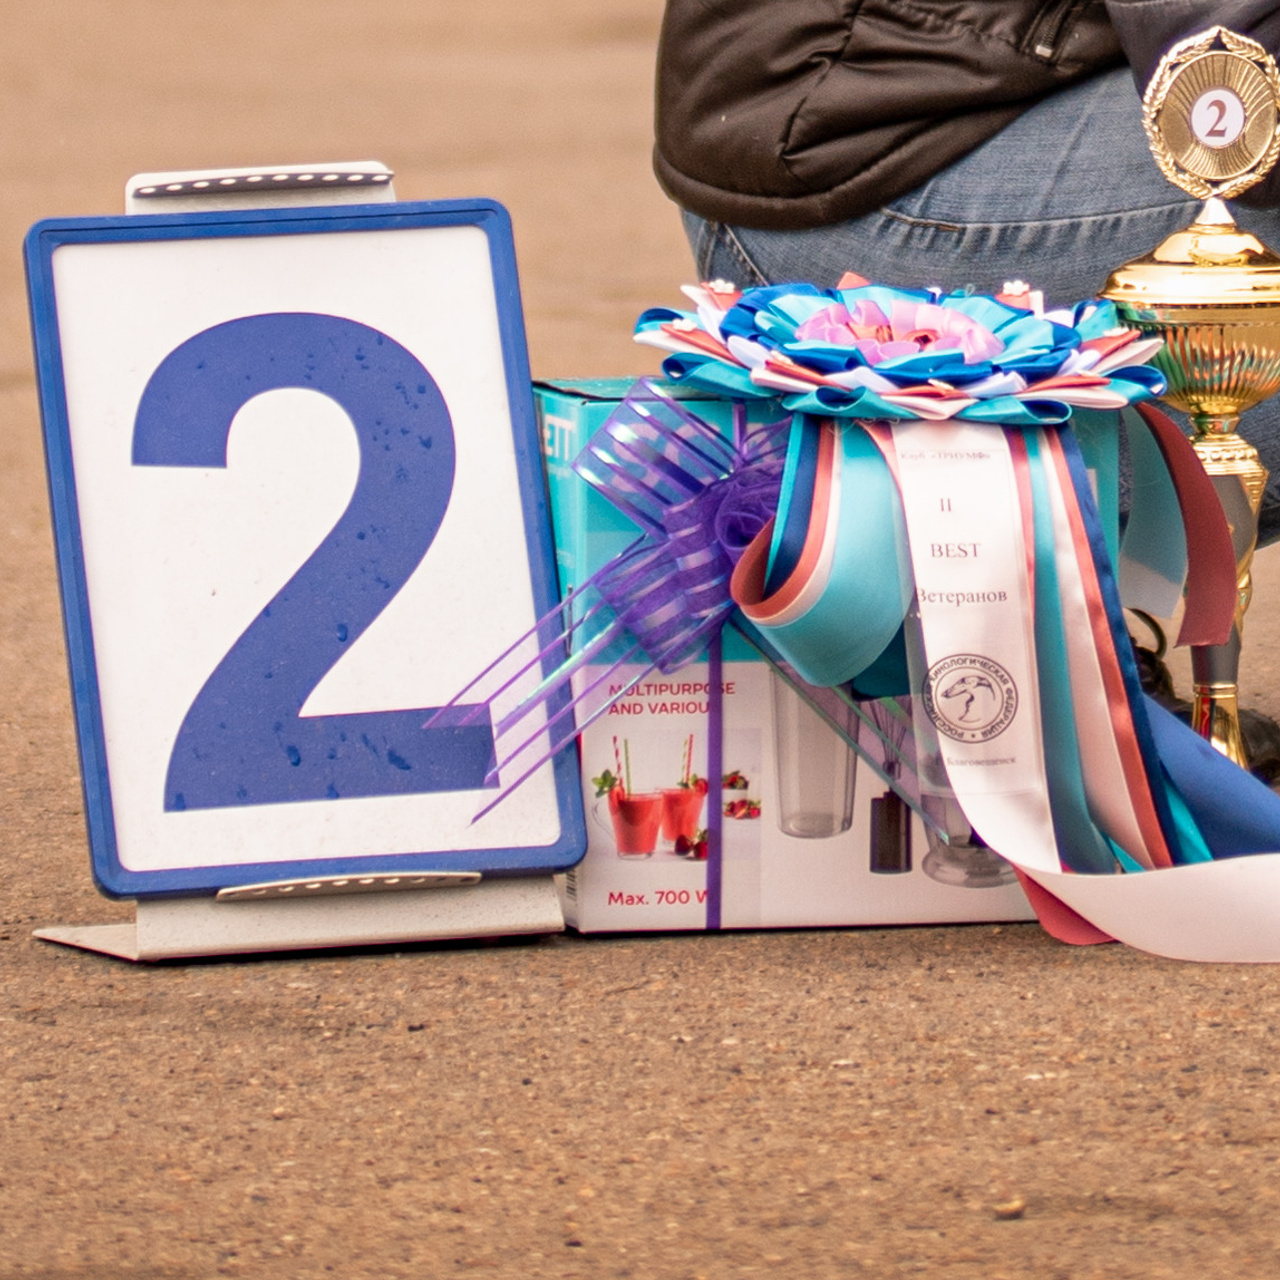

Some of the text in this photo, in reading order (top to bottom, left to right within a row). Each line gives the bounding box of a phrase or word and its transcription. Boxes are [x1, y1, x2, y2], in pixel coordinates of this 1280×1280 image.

[1205, 99, 1227, 138] 2
[930, 542, 982, 559] BEST
[131, 311, 501, 813] 2
[917, 587, 1008, 608] Ветеранов
[609, 701, 710, 715] AND VARIOU
[607, 891, 649, 906] Max.
[655, 890, 691, 905] 700
